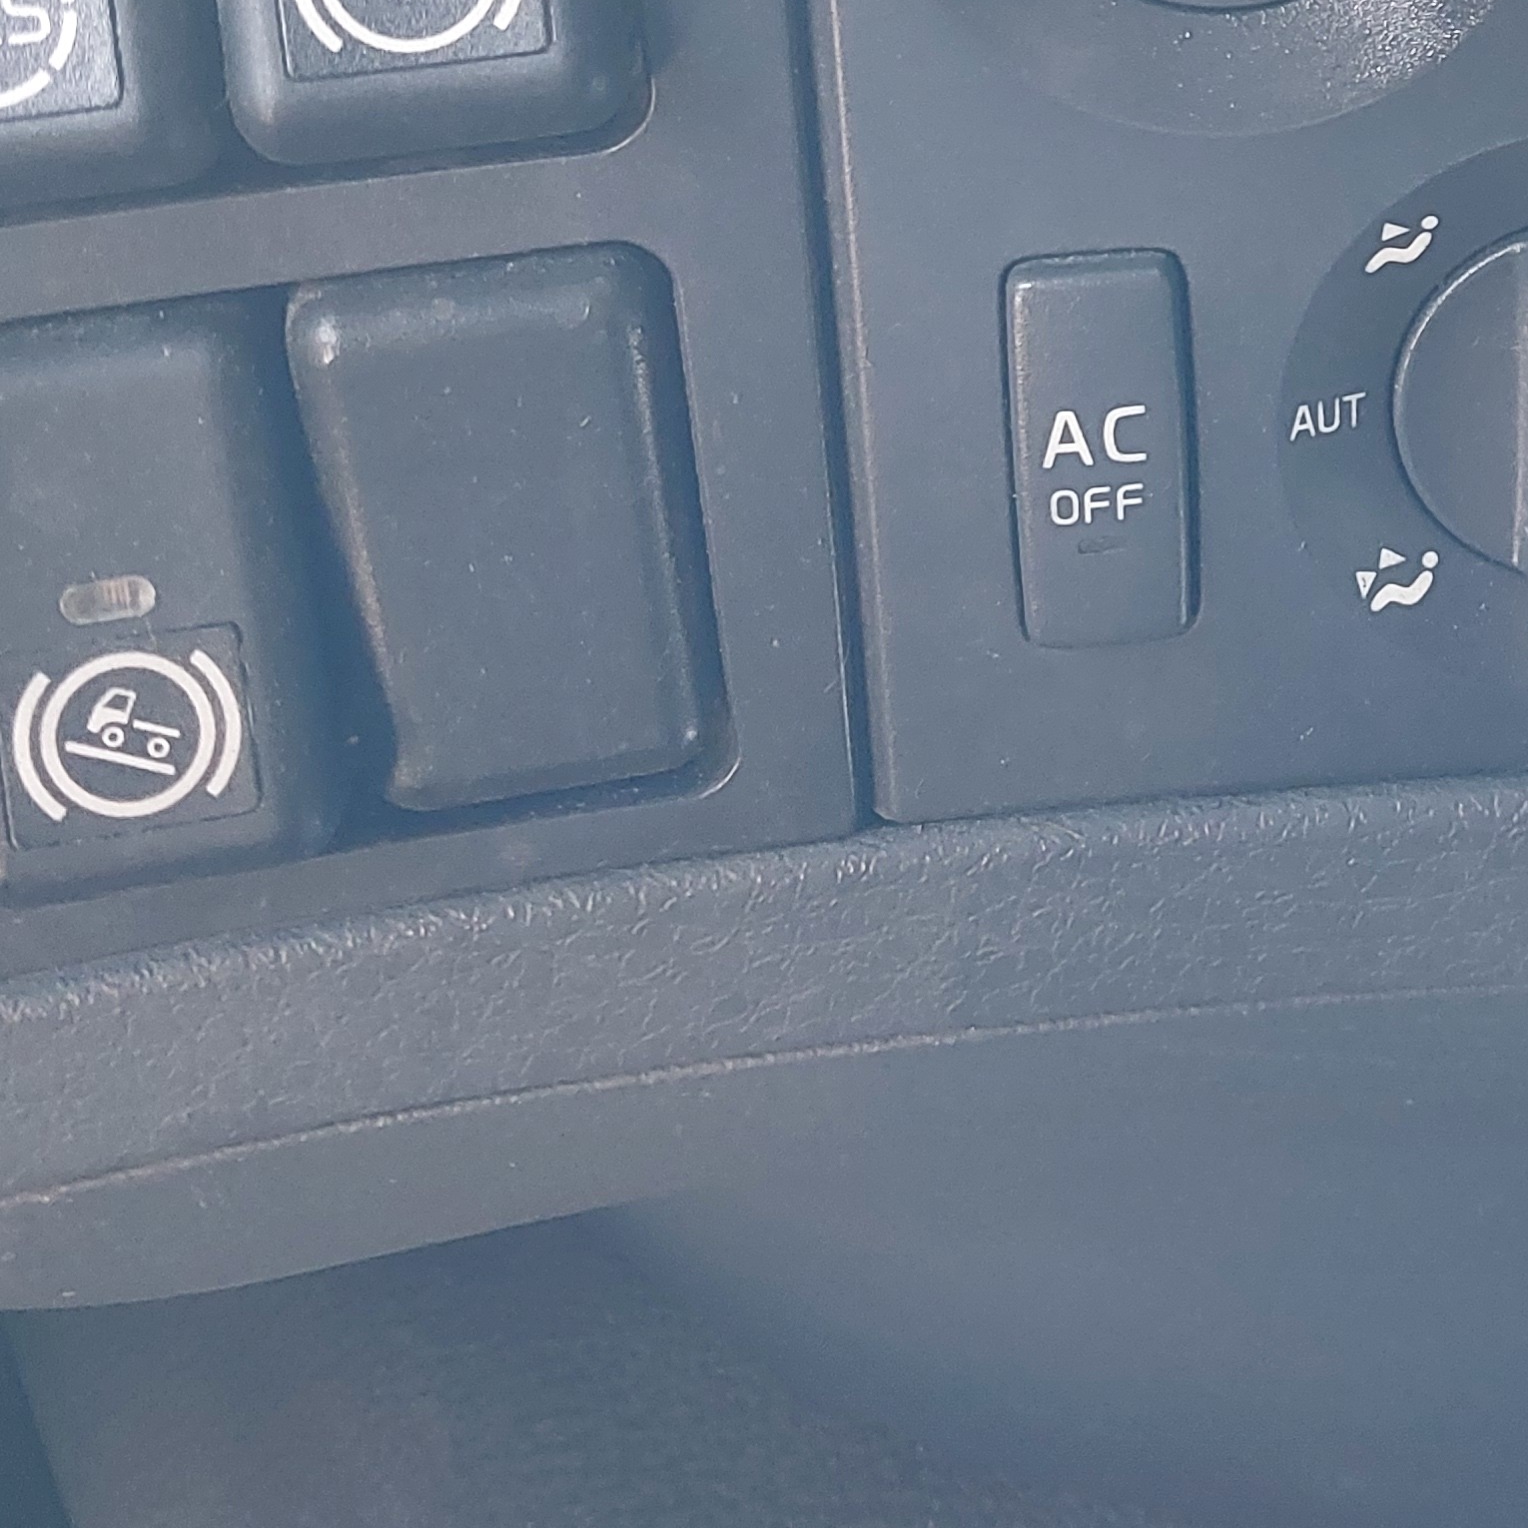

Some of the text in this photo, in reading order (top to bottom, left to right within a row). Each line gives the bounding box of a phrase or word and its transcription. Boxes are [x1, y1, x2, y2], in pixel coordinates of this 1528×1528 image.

[1042, 404, 1148, 469] AC
[1290, 391, 1366, 442] AUT
[1050, 482, 1144, 526] OFF
